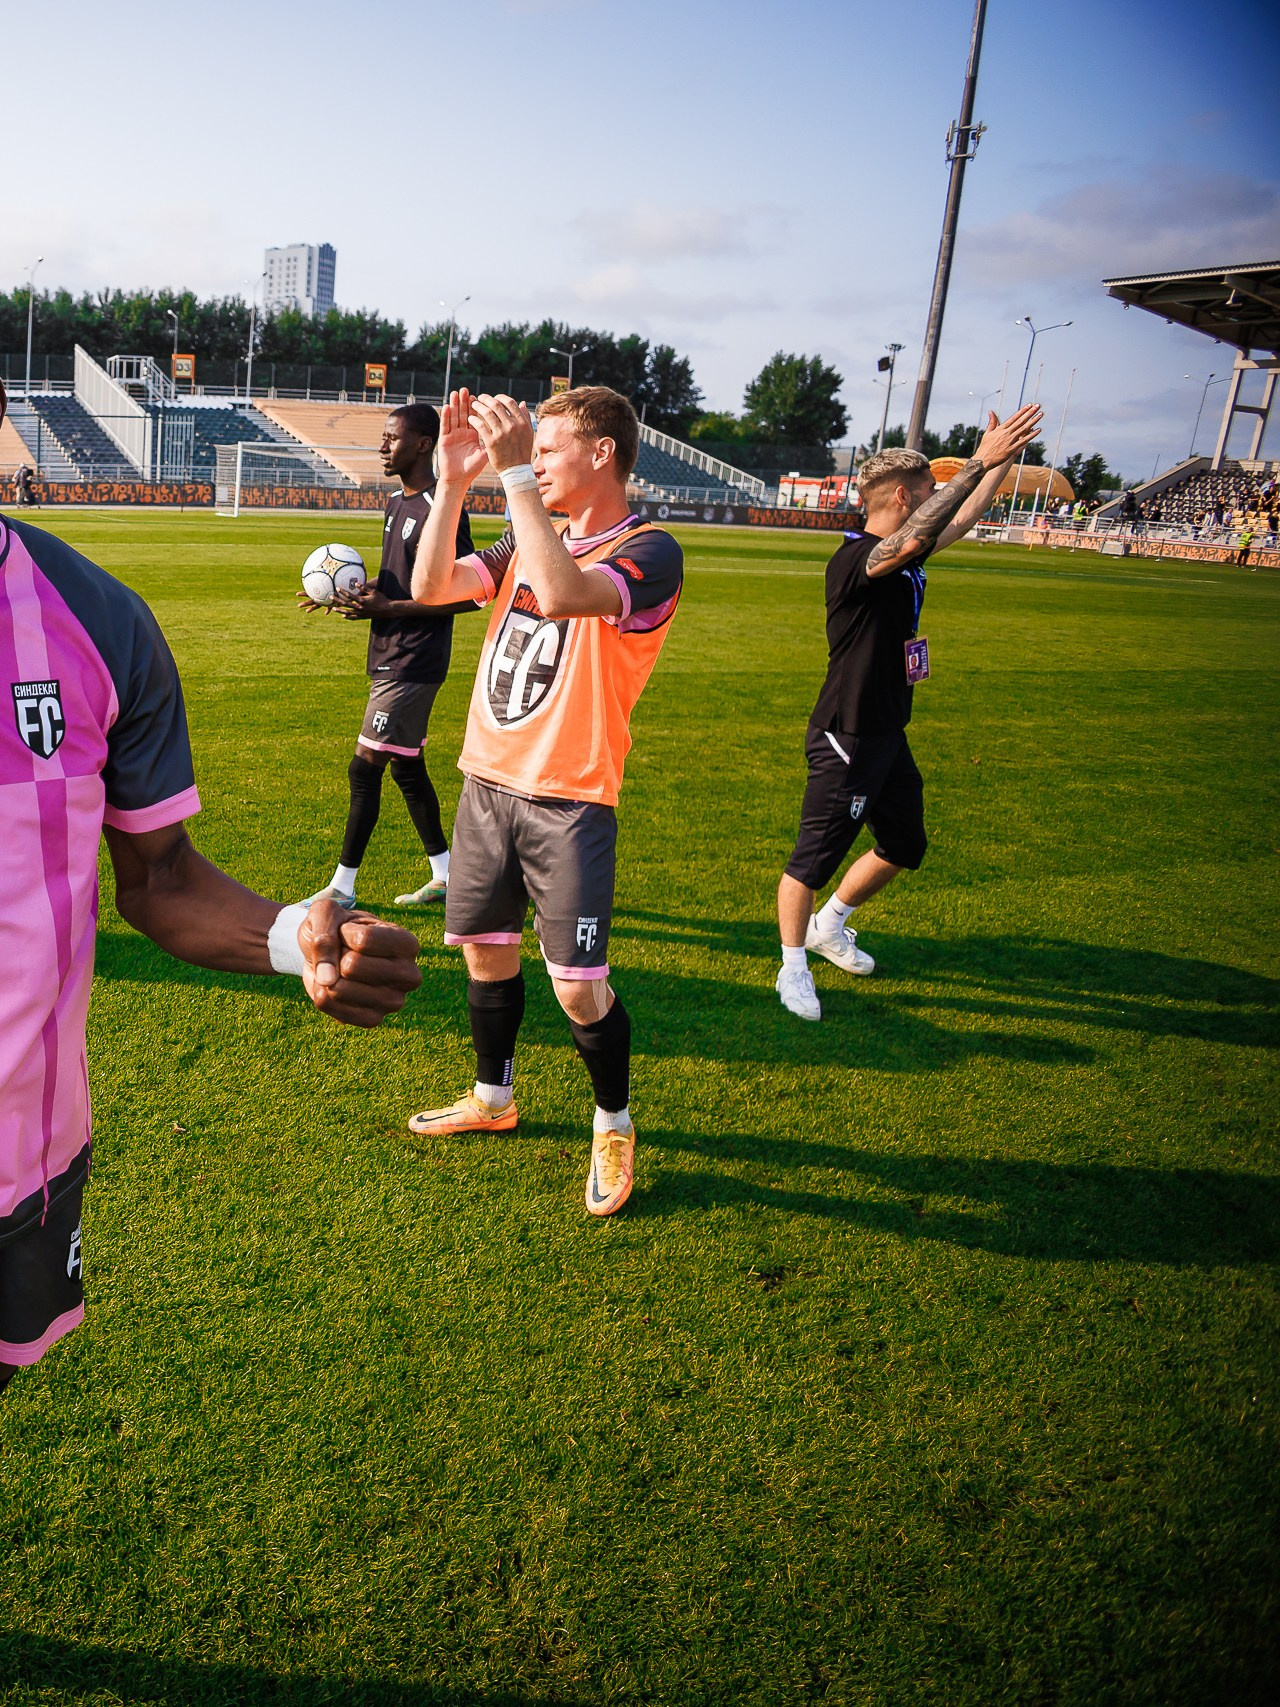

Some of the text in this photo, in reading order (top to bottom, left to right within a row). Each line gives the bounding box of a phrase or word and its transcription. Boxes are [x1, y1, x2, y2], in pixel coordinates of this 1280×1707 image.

[176, 363, 191, 372] D3
[369, 371, 383, 380] D4
[490, 611, 560, 720] FC
[14, 683, 58, 697] СИНДЕКАТ
[16, 697, 64, 756] FC
[576, 923, 597, 952] FC
[66, 1236, 82, 1280] F
